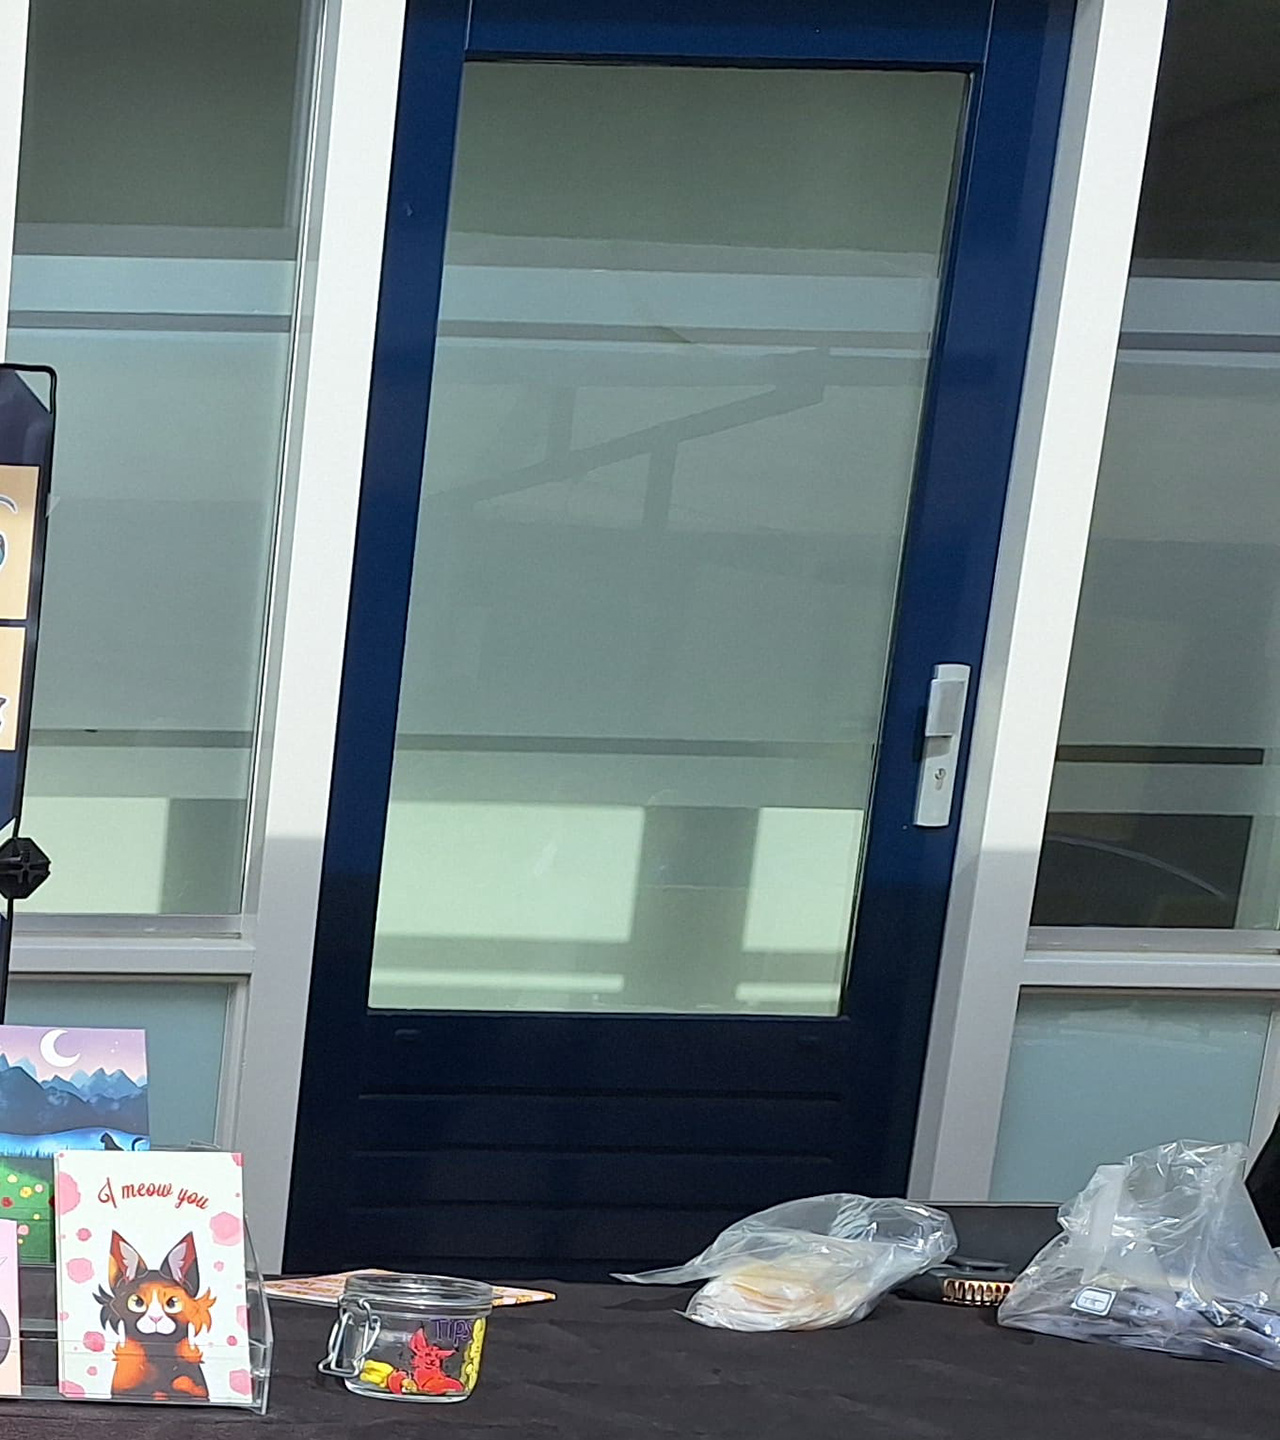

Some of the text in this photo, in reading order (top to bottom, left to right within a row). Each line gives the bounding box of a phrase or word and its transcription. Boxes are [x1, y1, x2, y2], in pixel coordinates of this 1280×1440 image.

[121, 1182, 173, 1199] meow
[175, 1187, 209, 1209] you
[429, 1318, 473, 1347] Tips
